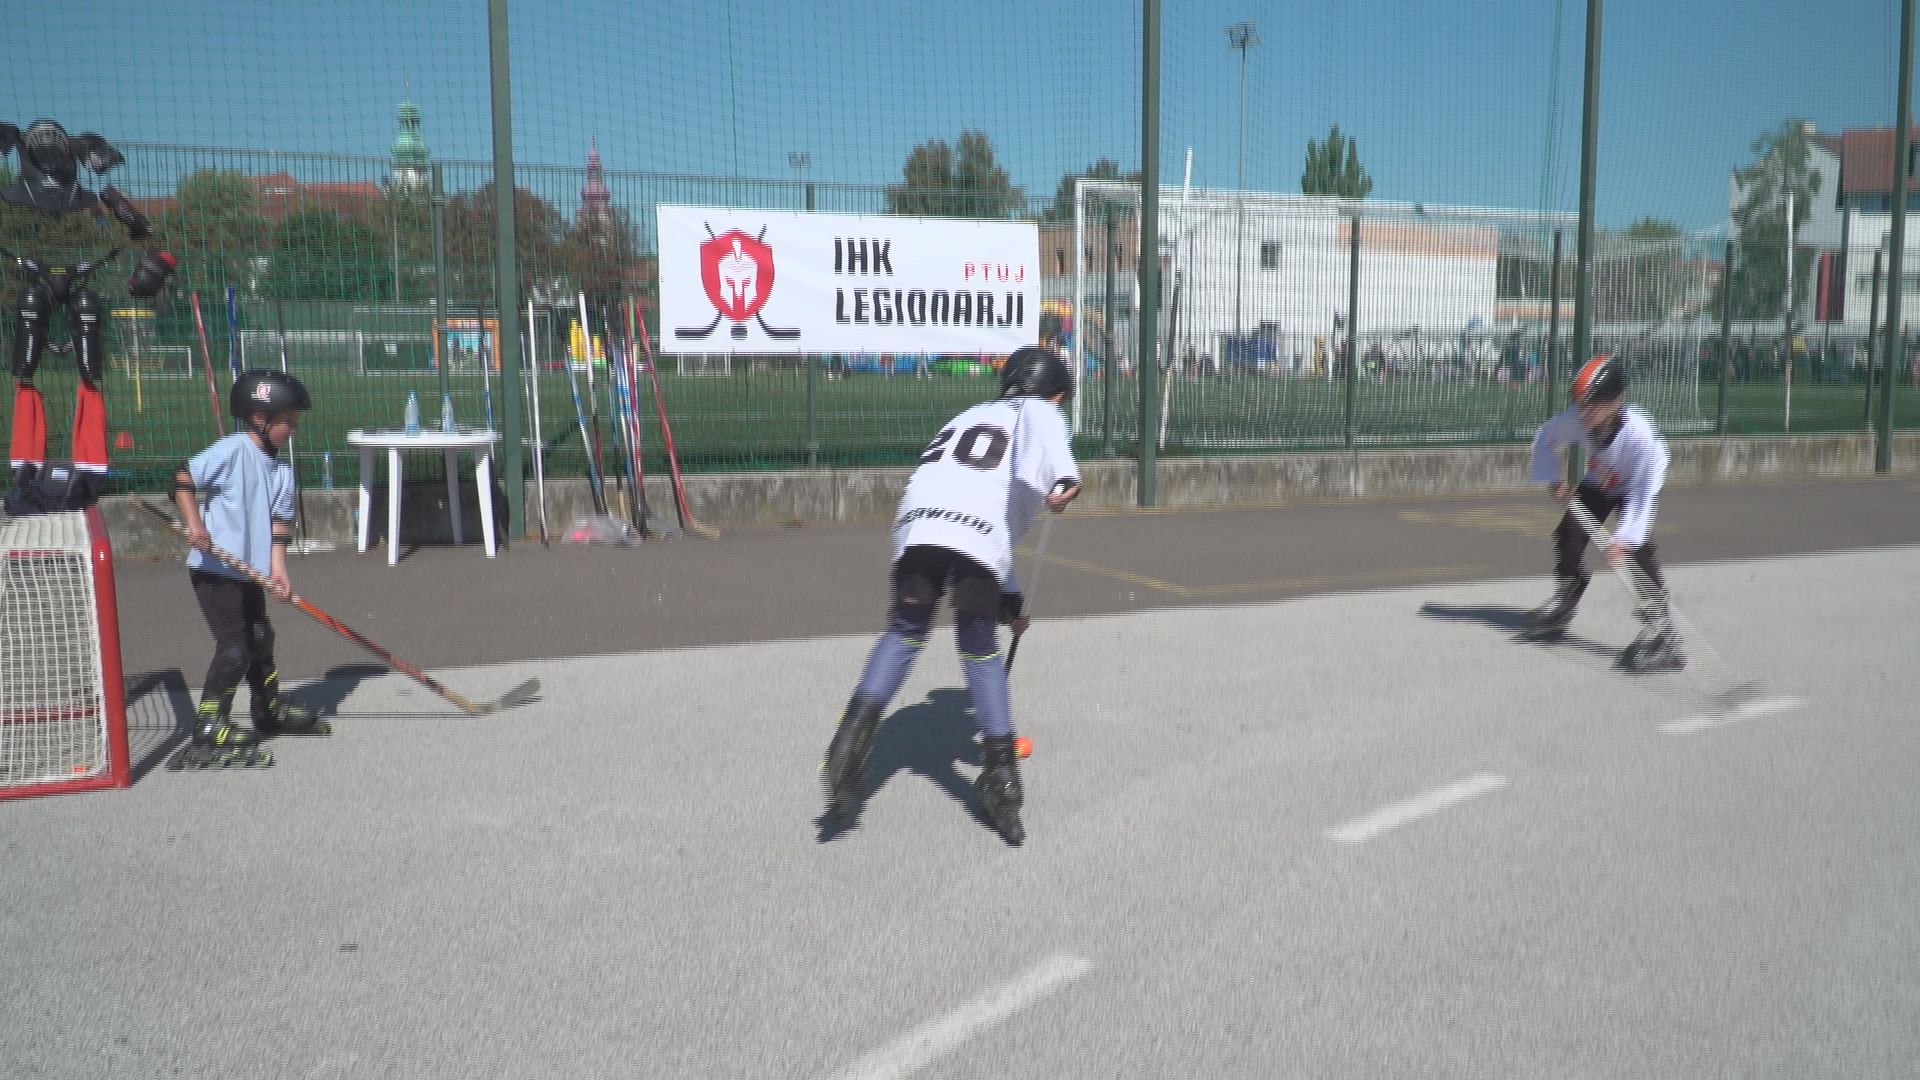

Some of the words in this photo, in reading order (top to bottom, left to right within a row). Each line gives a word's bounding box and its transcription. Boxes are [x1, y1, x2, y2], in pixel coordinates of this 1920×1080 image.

[834, 237, 893, 275] IHK
[964, 262, 1024, 283] PTUJ
[836, 288, 1024, 327] LEGIONARJI
[920, 423, 1011, 470] 20
